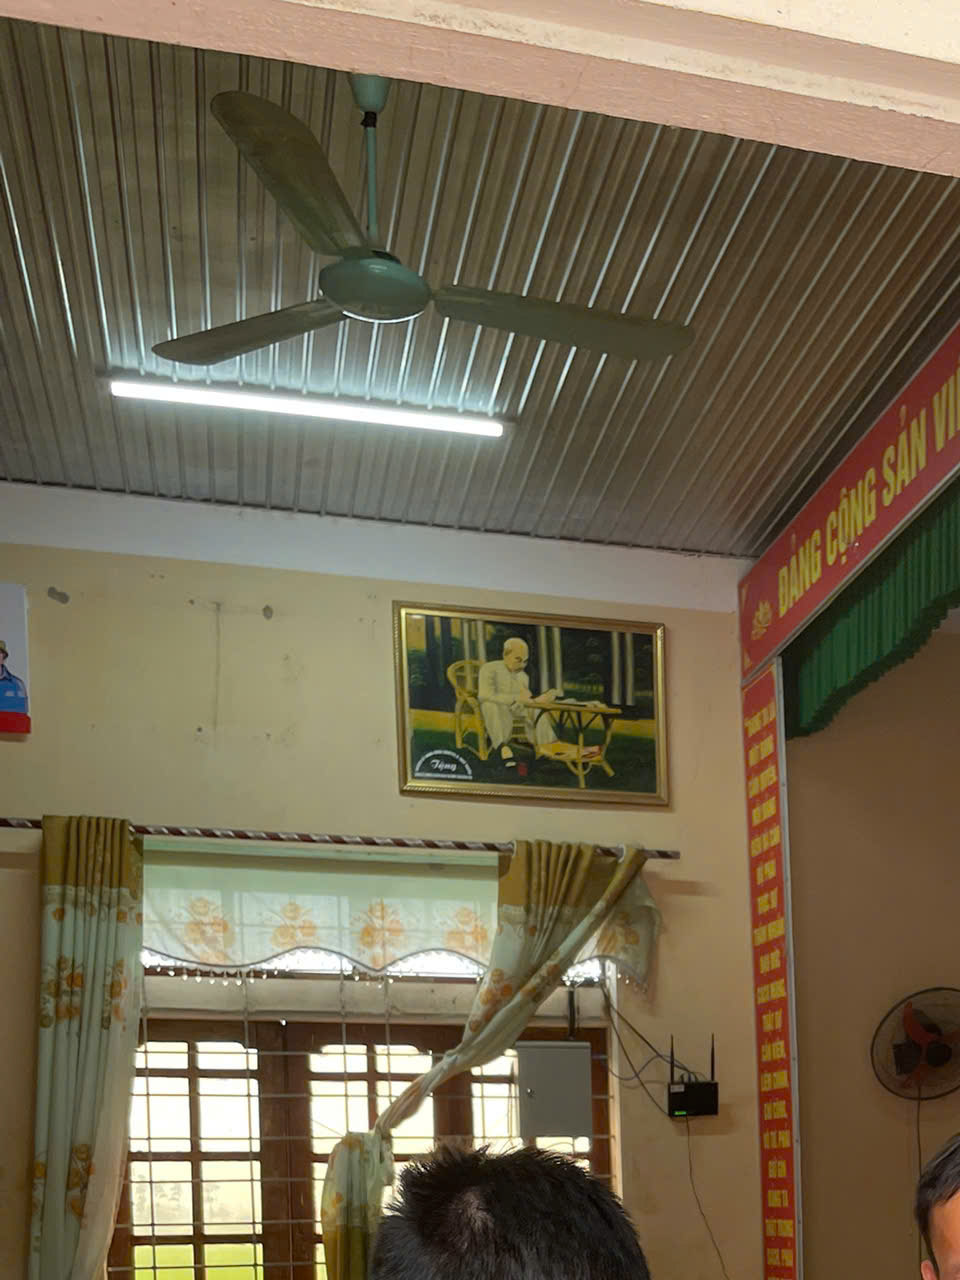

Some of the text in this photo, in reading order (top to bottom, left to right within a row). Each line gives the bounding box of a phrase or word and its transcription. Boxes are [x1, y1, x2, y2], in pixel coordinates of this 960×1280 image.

[777, 533, 822, 618] ĐẢNG
[826, 468, 877, 566] CỘNG
[882, 405, 927, 507] SẢN
